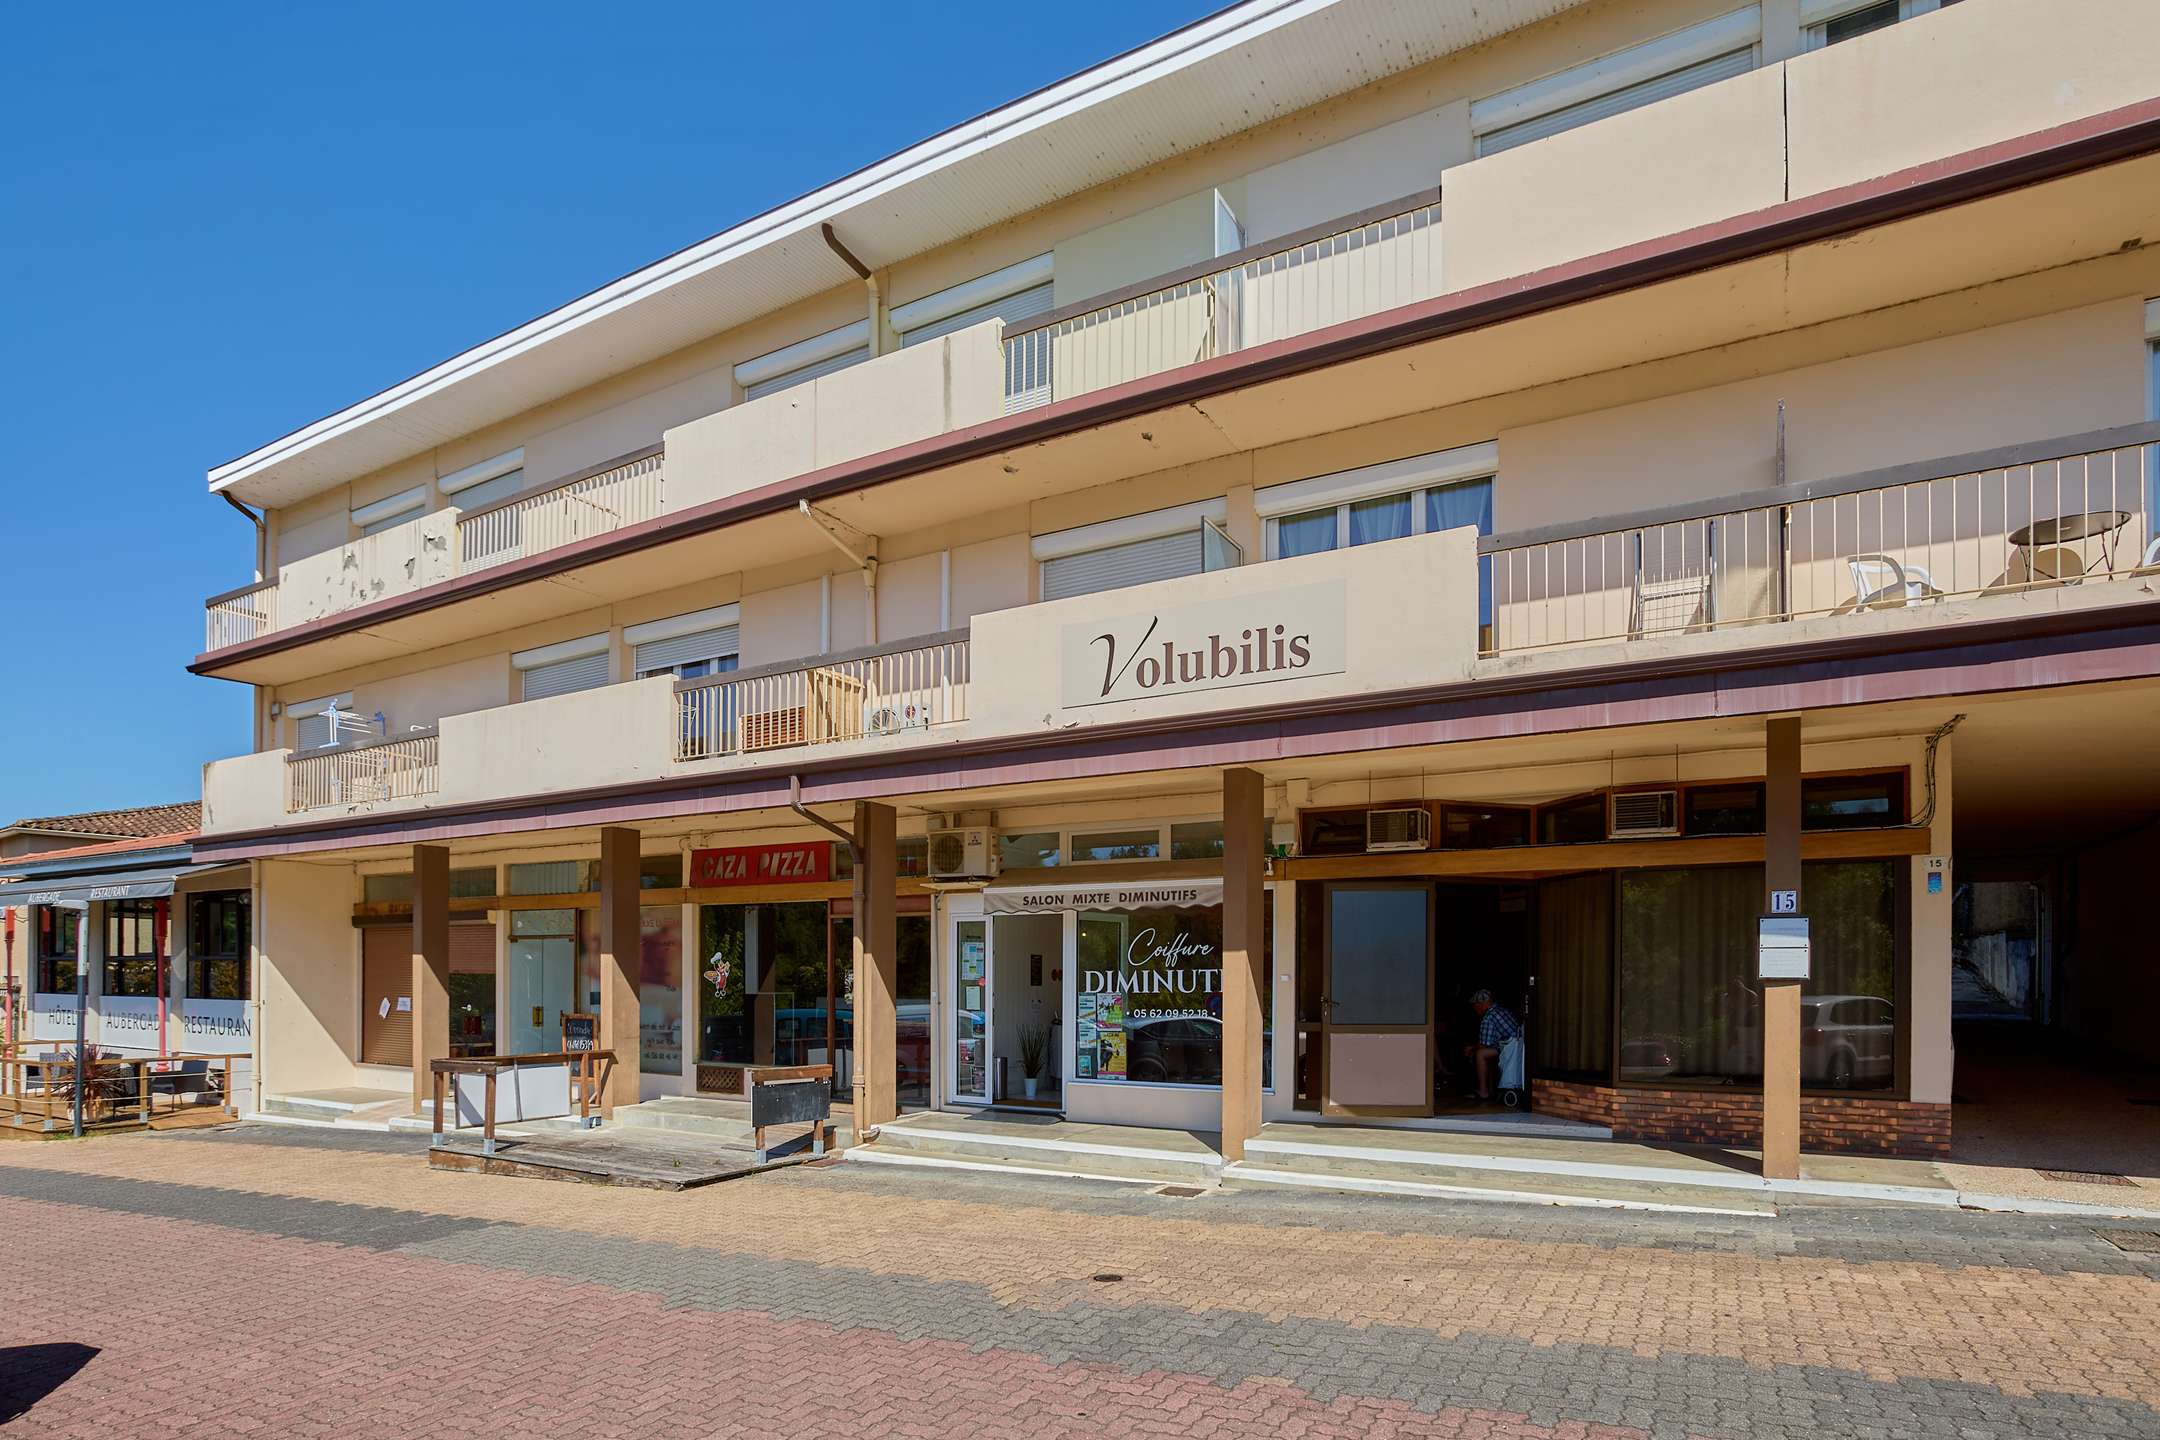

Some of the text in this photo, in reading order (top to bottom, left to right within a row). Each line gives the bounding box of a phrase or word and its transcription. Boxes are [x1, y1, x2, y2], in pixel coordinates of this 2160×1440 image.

[1090, 616, 1311, 697] Volubilis
[703, 849, 816, 879] CAZA PIZZA
[1929, 859, 1942, 868] 15
[90, 885, 130, 899] RESTAURANT
[1022, 889, 1198, 906] SALON MIXTE DIMINUTIFS
[1774, 893, 1795, 910] 15
[1127, 927, 1215, 967] Coiffure
[1084, 968, 1223, 994] DIMINUTI
[106, 1011, 160, 1031] AUBERGAD
[1133, 1009, 1208, 1018] 05 62 09 52 18
[184, 1015, 251, 1036] RESTAURAN
